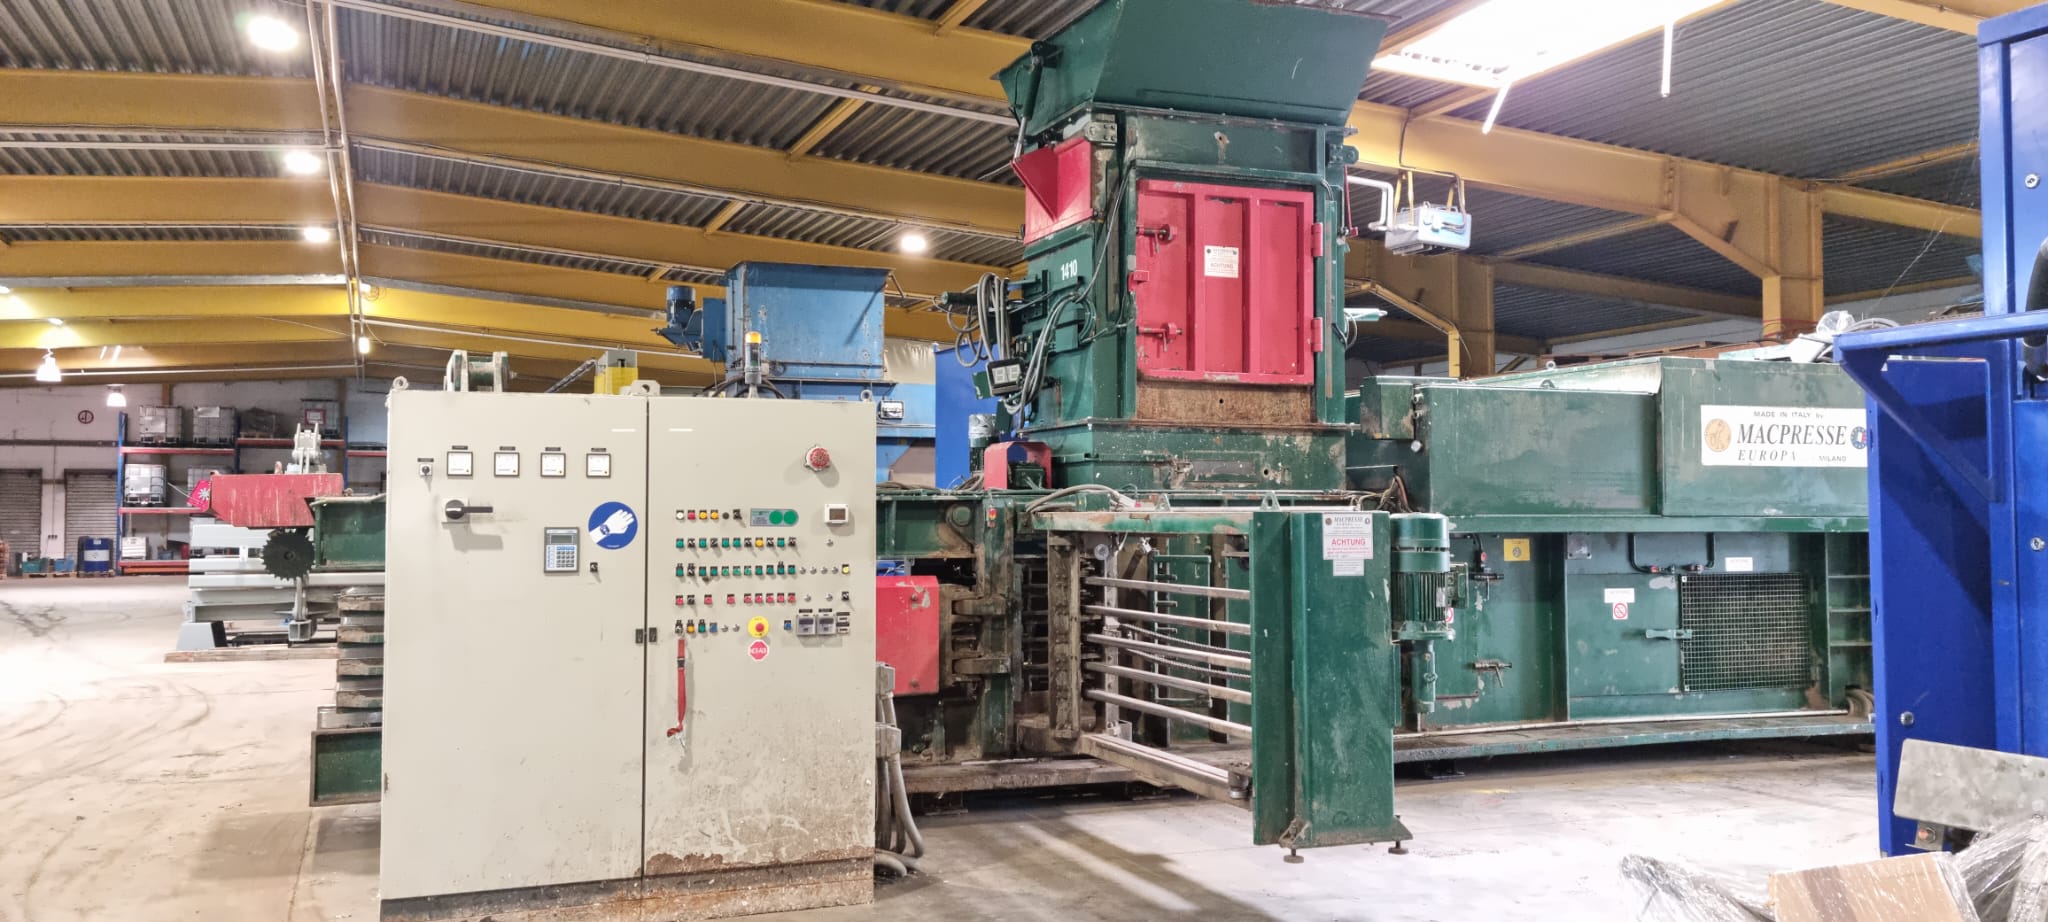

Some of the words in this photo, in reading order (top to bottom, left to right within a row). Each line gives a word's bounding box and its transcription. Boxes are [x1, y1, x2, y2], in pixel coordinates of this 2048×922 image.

[1060, 259, 1078, 281] 1410
[1791, 411, 1811, 419] ITALY
[1737, 424, 1847, 445] MACPRESSE
[1738, 449, 1796, 461] EUROPA
